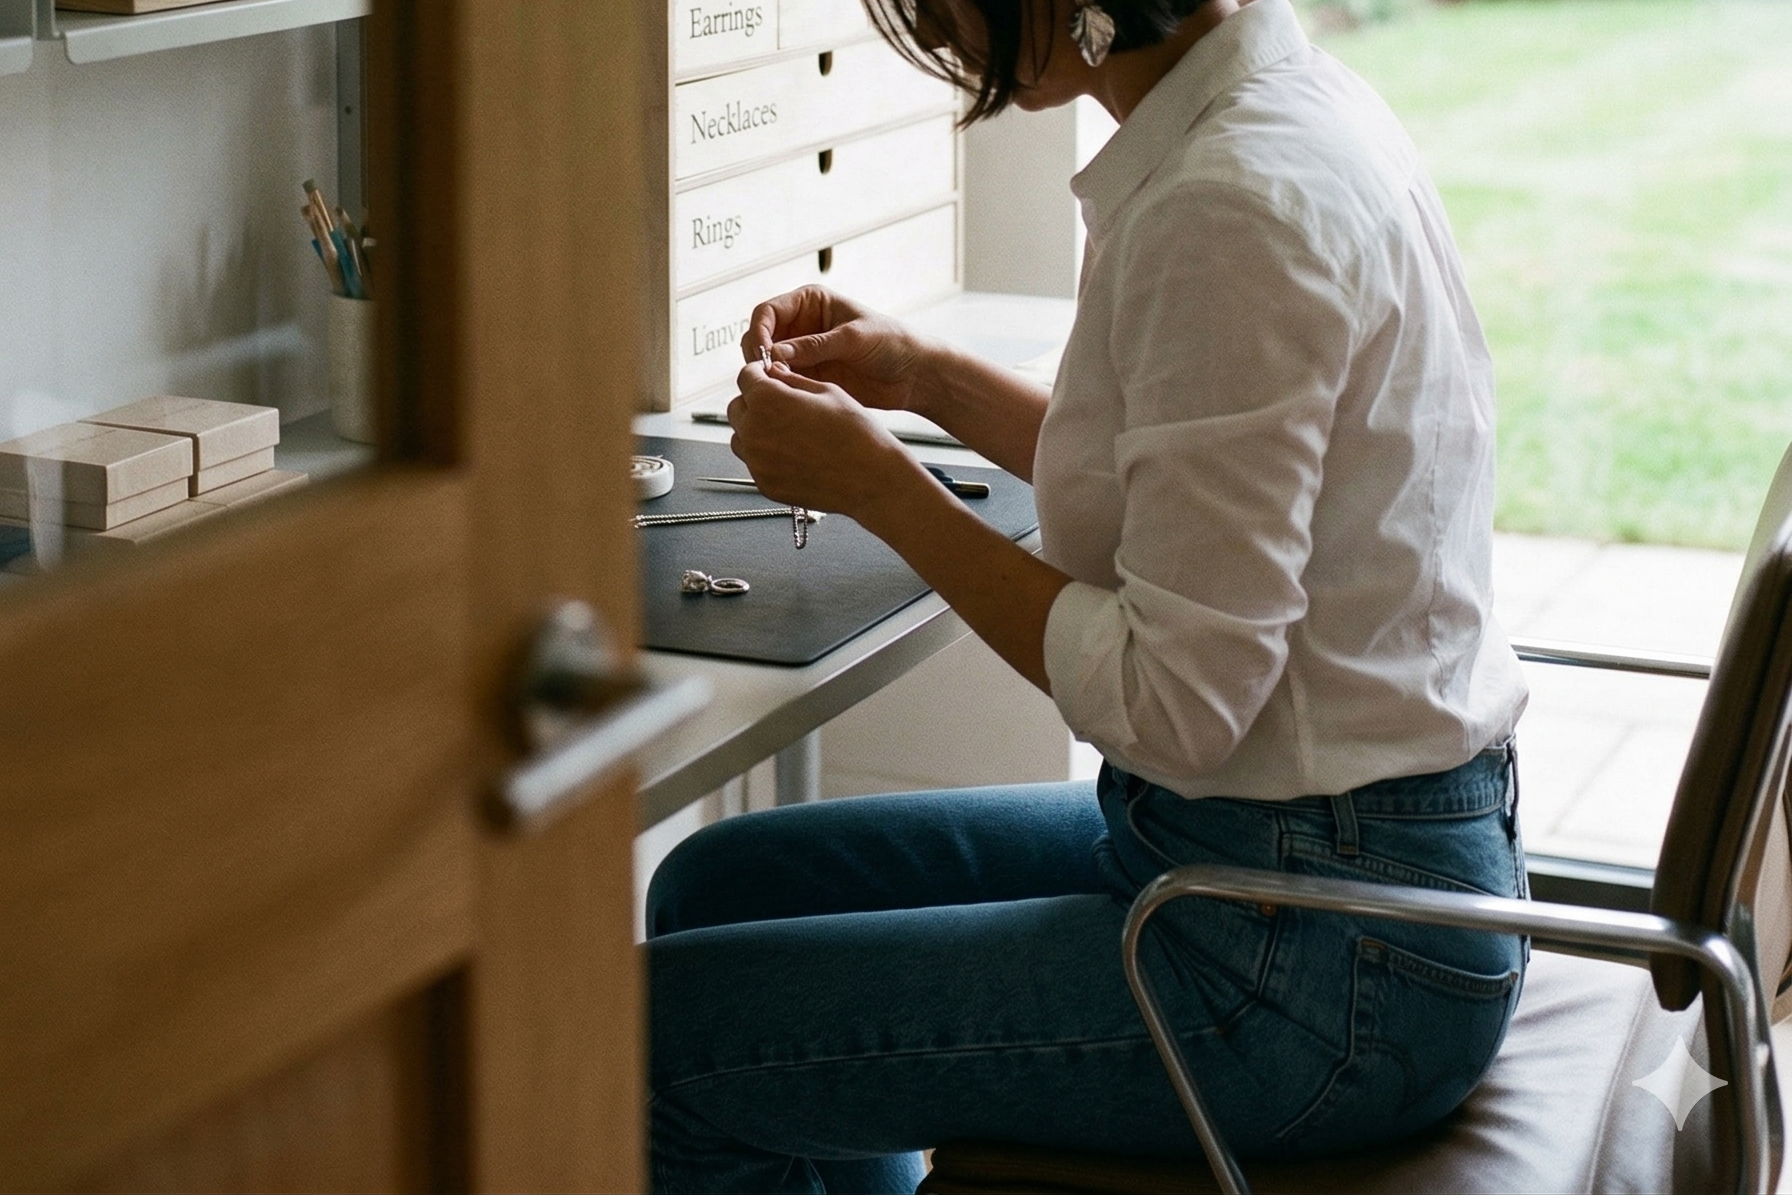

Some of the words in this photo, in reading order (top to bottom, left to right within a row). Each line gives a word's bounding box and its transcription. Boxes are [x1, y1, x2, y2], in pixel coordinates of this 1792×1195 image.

[689, 1, 763, 39] Earrings
[691, 100, 778, 145] Necklaces
[692, 214, 742, 249] Rings
